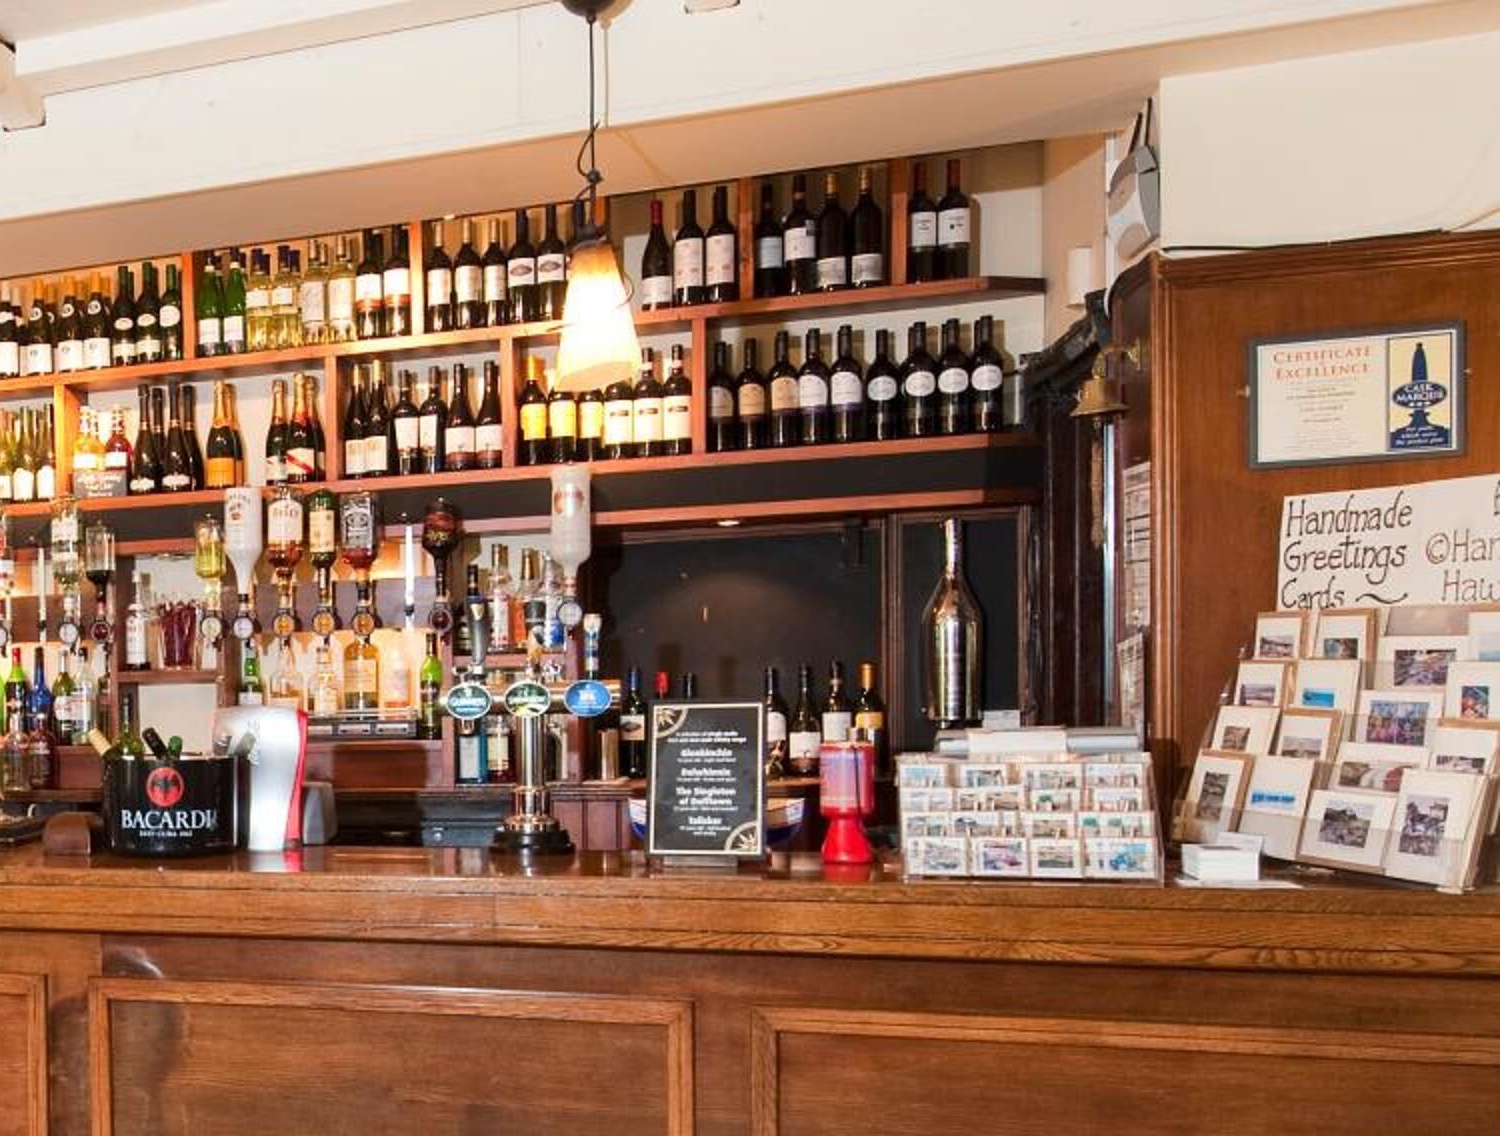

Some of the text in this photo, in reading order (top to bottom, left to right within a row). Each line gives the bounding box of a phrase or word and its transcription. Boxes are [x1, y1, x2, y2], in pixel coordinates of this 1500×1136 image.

[1286, 490, 1413, 537] Handmade
[1283, 536, 1408, 585] Greetings
[1281, 576, 1345, 610] Cards
[121, 809, 211, 829] BACARDI
